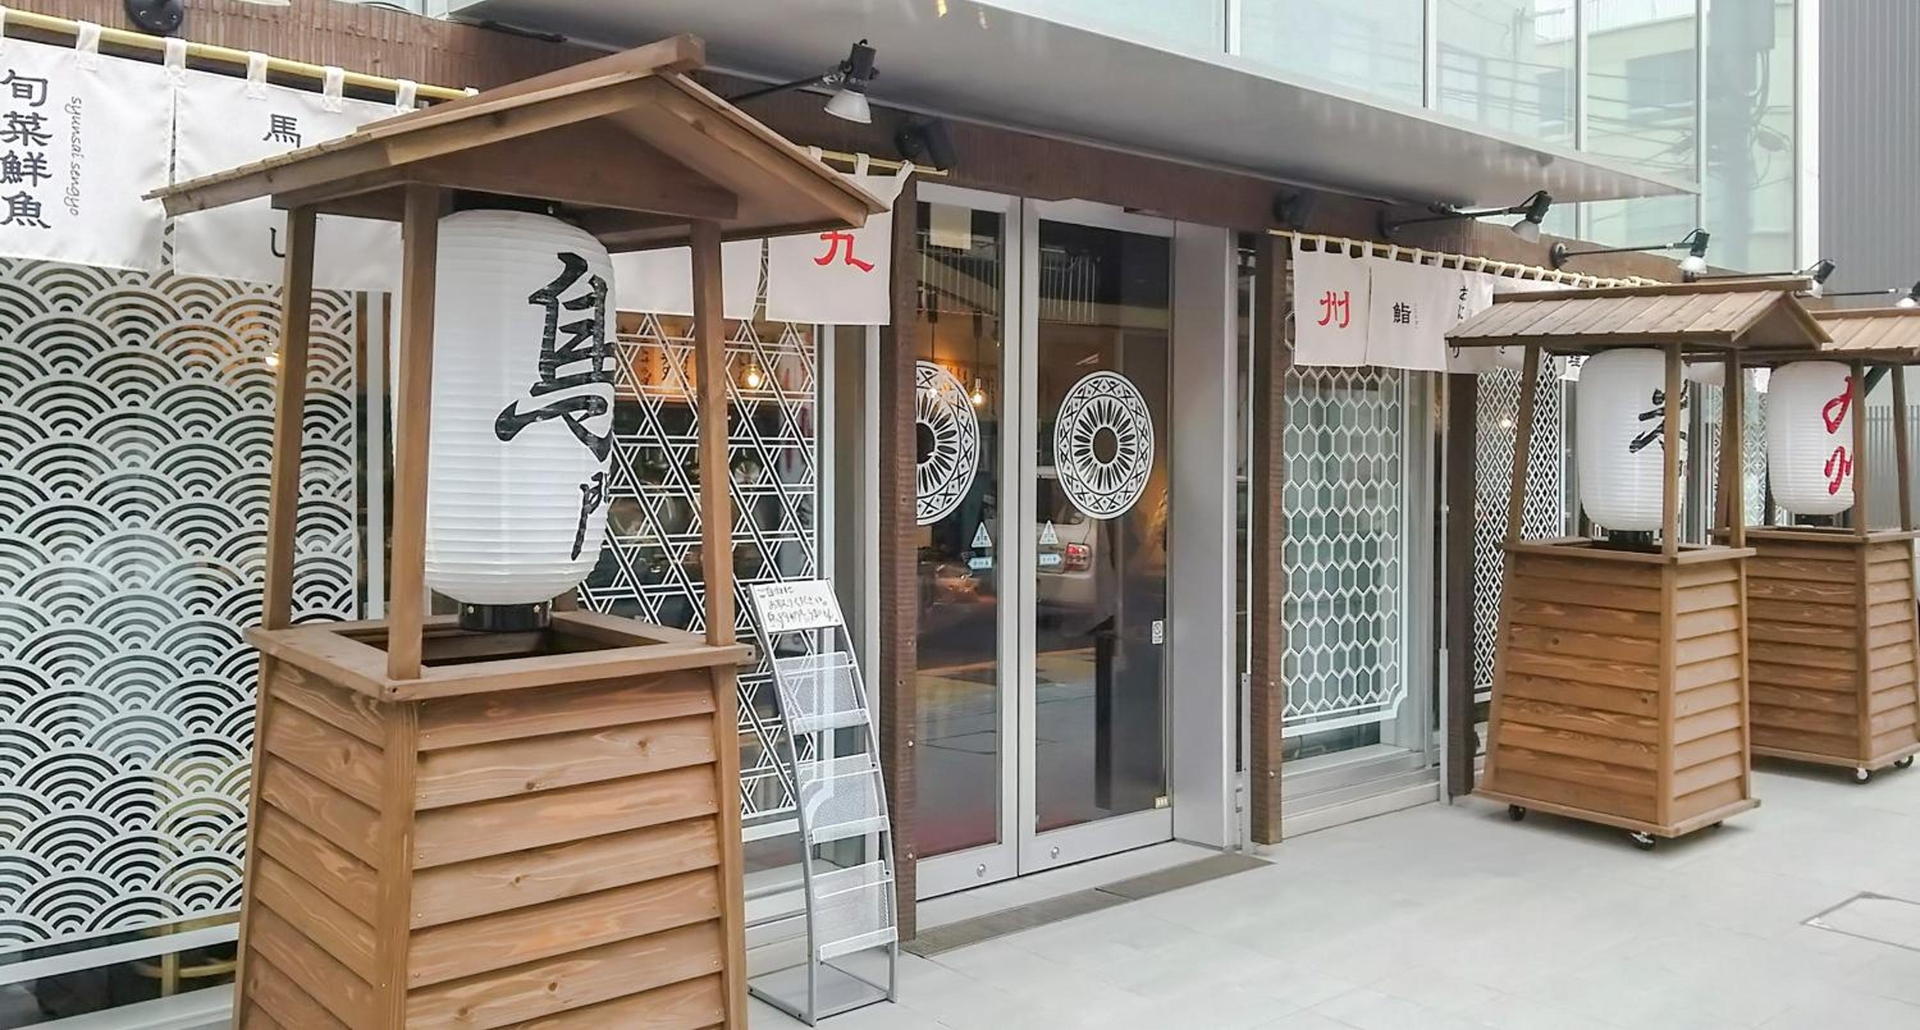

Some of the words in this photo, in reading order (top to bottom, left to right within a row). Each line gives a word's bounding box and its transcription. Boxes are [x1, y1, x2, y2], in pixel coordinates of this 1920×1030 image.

[0, 68, 53, 229] 旬菜鮮魚
[64, 96, 84, 159] syunsai
[63, 161, 81, 217] sengyo
[813, 229, 875, 273] 九
[1316, 290, 1350, 329] 州
[1392, 301, 1413, 325] 鮨
